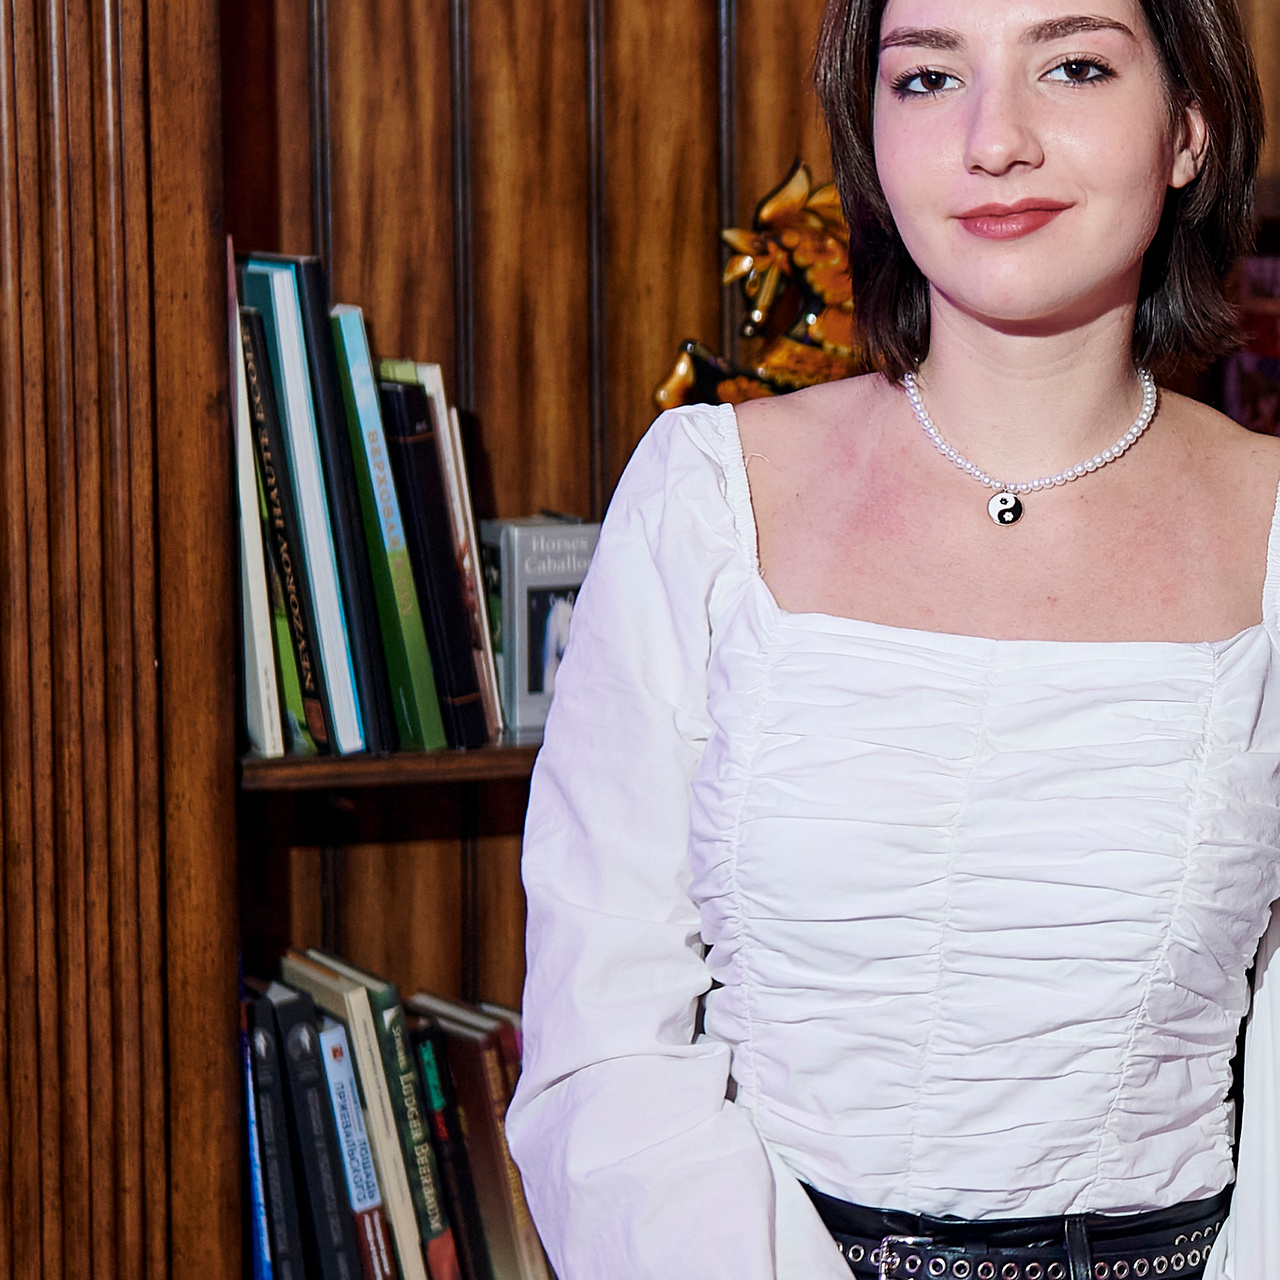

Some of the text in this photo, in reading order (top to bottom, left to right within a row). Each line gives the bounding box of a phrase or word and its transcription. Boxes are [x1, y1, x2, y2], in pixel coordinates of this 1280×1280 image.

[257, 428, 285, 529] HAUTE
[367, 430, 400, 547] ВЕРХОВАЯ
[524, 554, 589, 575] Caballo
[532, 535, 589, 552] Horses
[277, 532, 316, 693] NEVZOROV
[357, 1137, 376, 1201] ЛОШАДЬ
[399, 1072, 424, 1142] LUDGER
[414, 1143, 444, 1233] BEERBAUM
